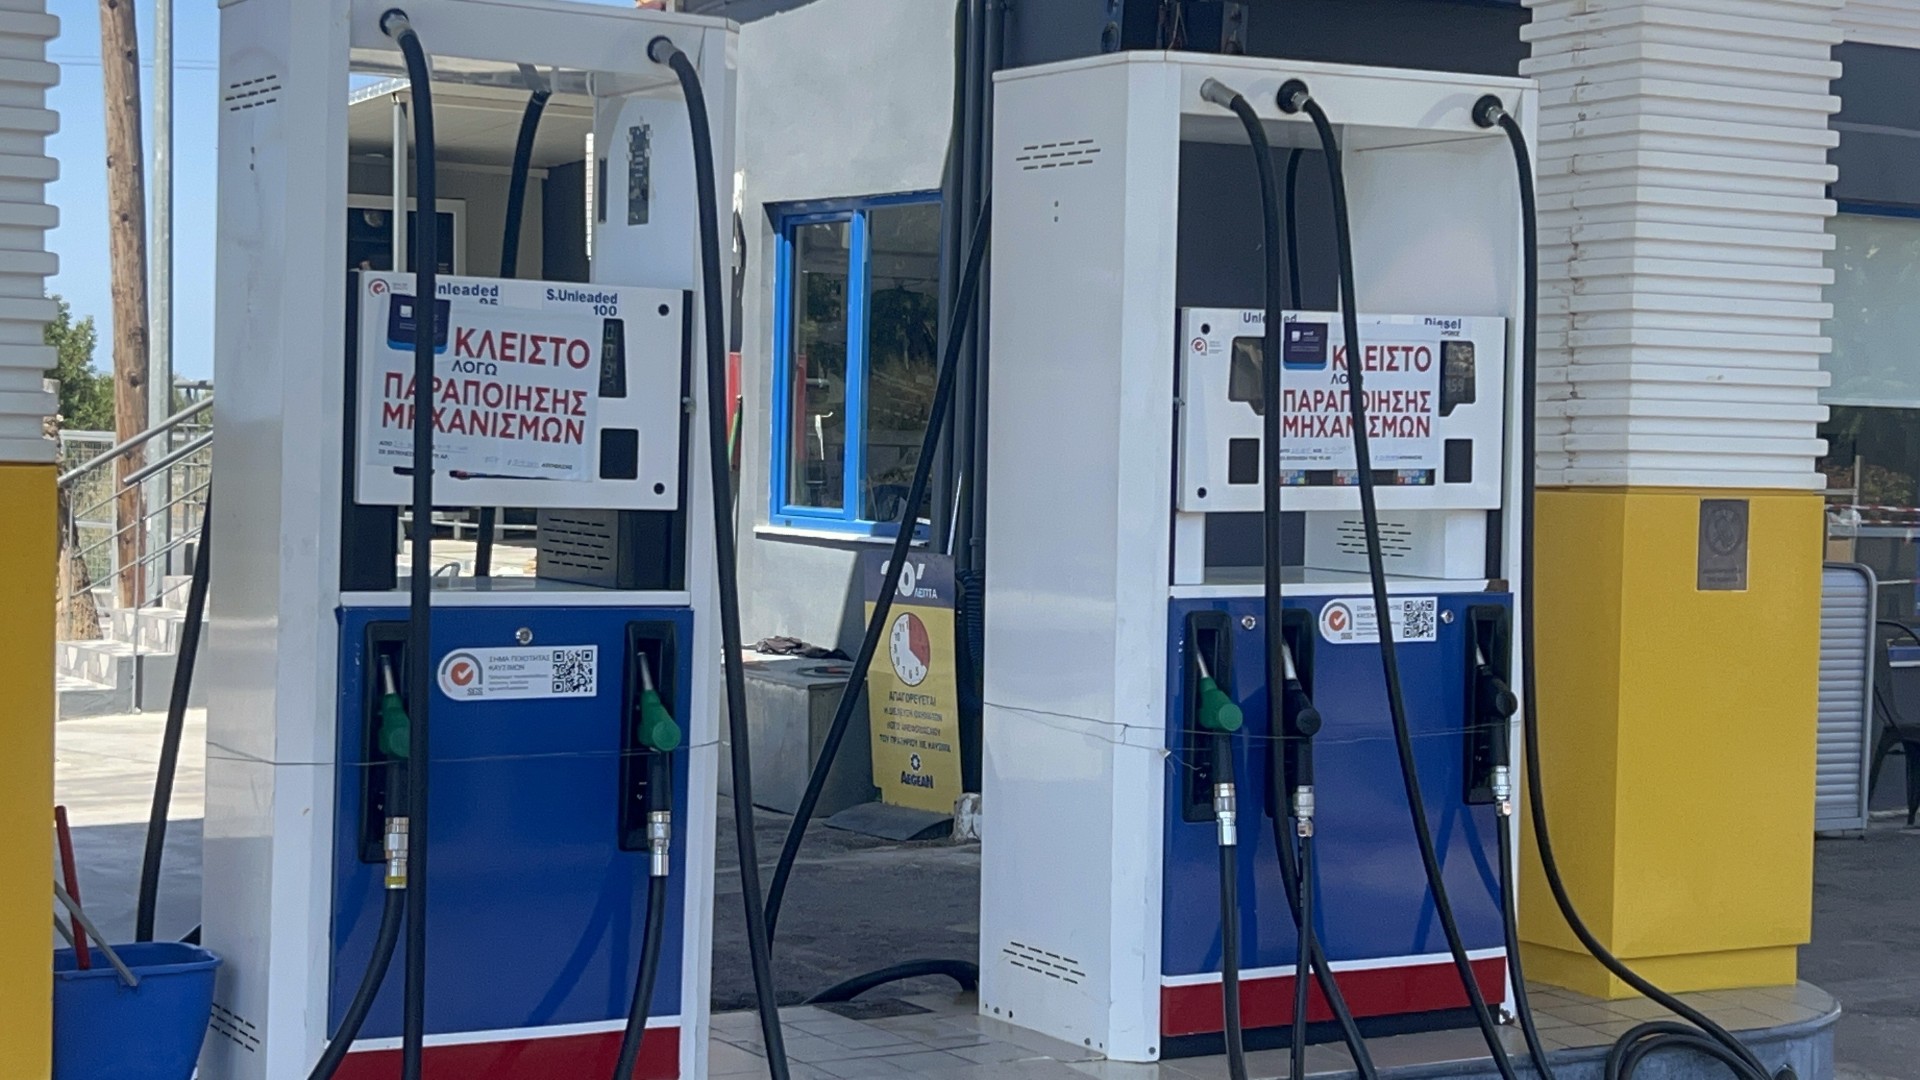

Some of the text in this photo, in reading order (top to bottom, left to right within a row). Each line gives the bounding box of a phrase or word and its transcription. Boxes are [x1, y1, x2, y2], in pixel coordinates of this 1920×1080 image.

[438, 282, 499, 297] nleaded
[546, 288, 618, 304] S.Unleaded
[593, 305, 618, 317] 100
[454, 326, 591, 370] ΚΛΕΙΣΤΟ
[1332, 344, 1432, 373] ΚΕΙΣΤΟ
[451, 359, 498, 377] ΛΟΓΩ
[1282, 415, 1431, 438] ΜΗΧΑΝΣΜΩΝ
